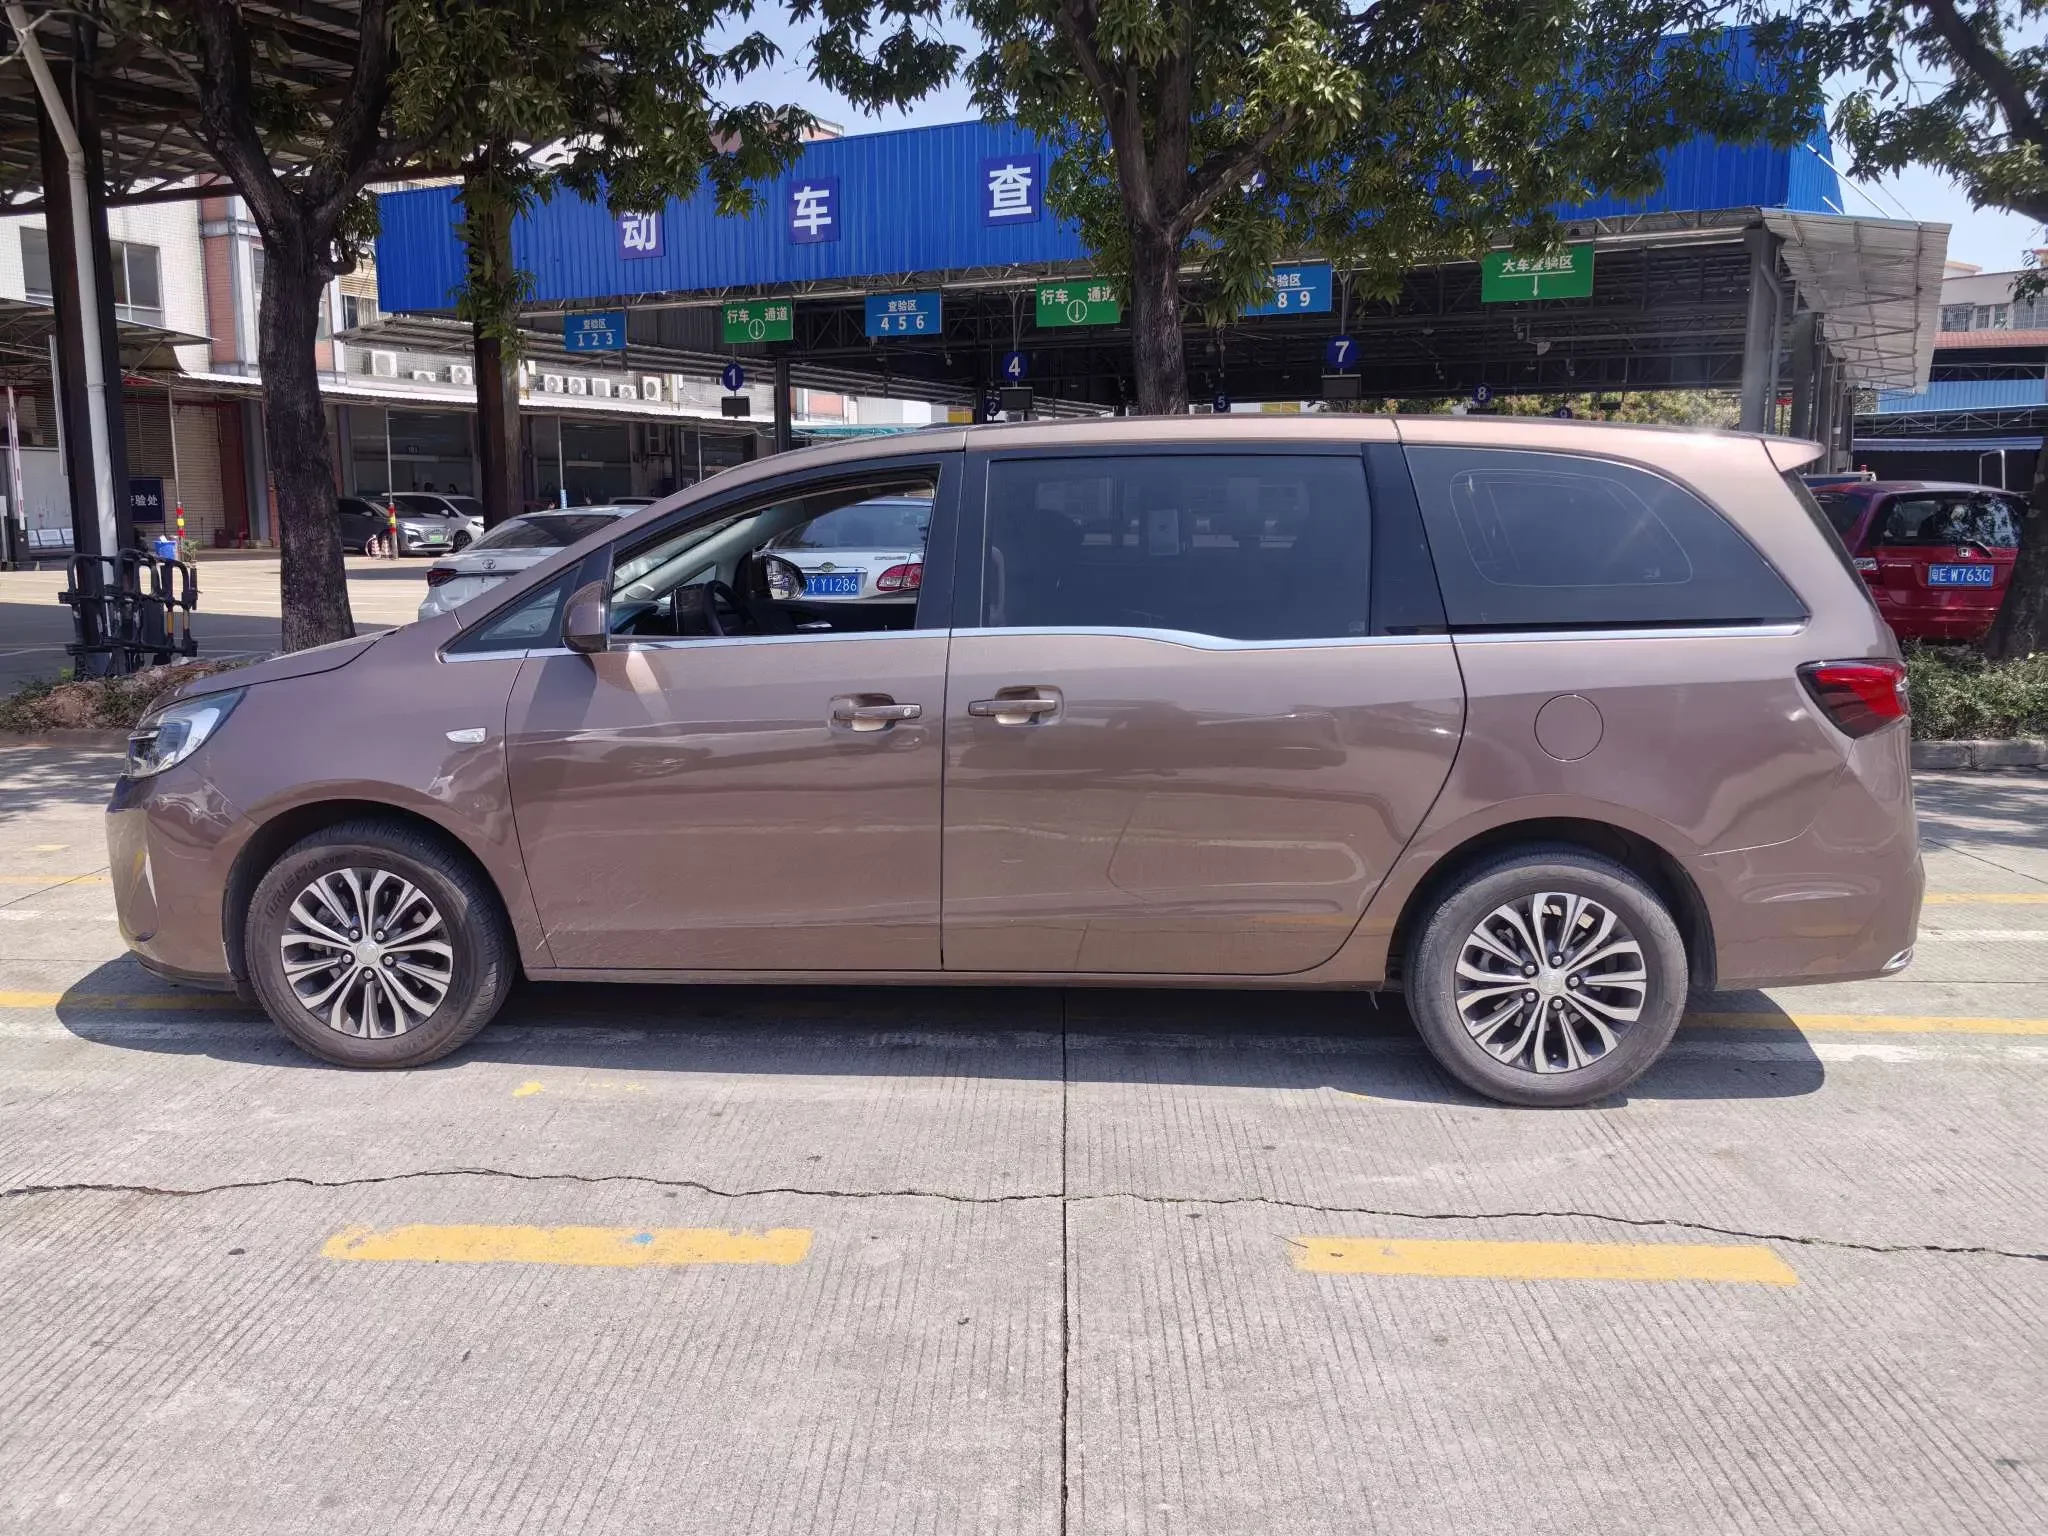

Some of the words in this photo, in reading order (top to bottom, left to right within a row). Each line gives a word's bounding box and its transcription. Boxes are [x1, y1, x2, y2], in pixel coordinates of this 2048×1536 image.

[622, 209, 656, 251] 动
[793, 186, 832, 236] 车
[988, 164, 1032, 217] 查
[888, 299, 917, 312] 查验区
[1040, 288, 1069, 306] 行车
[1278, 292, 1288, 308] 8
[1300, 290, 1311, 307] 9
[727, 308, 750, 324] 行车
[764, 306, 788, 321] 通道
[881, 317, 889, 331] 4
[899, 316, 907, 330] 5
[916, 315, 924, 329] 6
[578, 334, 584, 347] 1
[592, 333, 600, 346] 2
[606, 332, 614, 345] 3
[1335, 340, 1350, 363] 7
[1008, 356, 1021, 377] 4
[728, 368, 736, 387] 1
[1477, 386, 1487, 401] 8
[988, 401, 997, 415] 2
